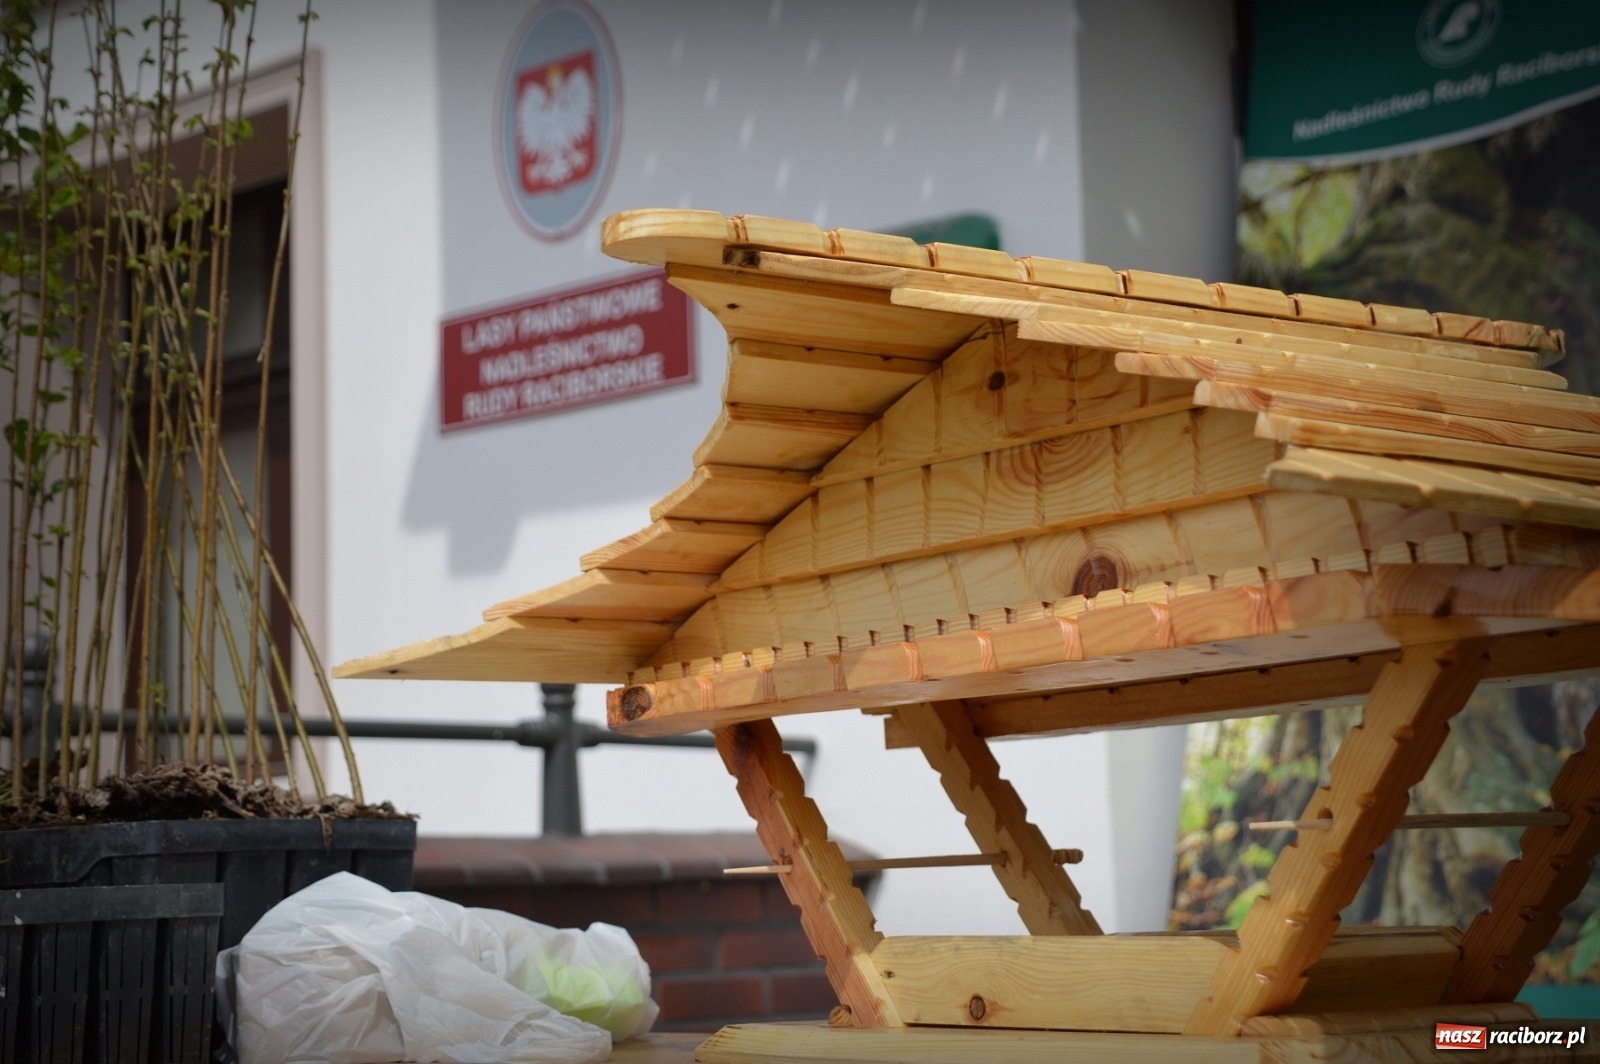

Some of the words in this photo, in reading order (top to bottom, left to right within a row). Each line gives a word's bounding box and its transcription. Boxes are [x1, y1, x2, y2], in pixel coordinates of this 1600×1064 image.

[1433, 72, 1492, 103] Rudy
[462, 313, 516, 354] LASY
[463, 387, 517, 419] RUDY
